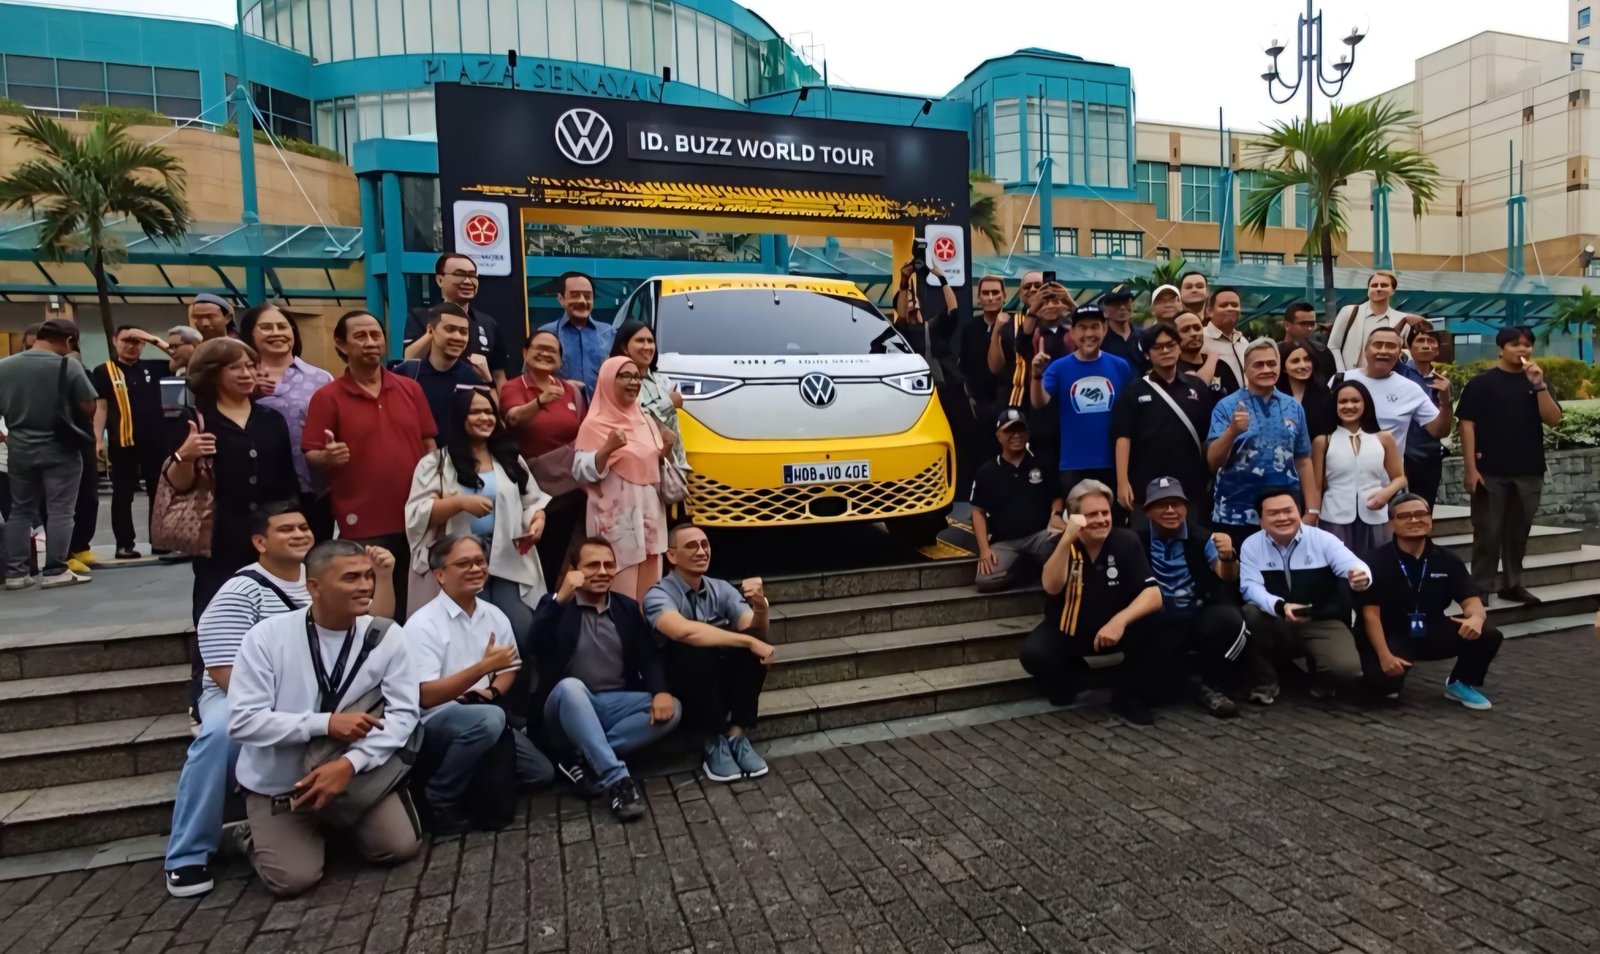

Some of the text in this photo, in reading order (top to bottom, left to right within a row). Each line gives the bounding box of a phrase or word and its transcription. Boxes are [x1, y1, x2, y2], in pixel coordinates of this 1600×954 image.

[640, 131, 874, 166] ID. BUZZ WORLD TOUR
